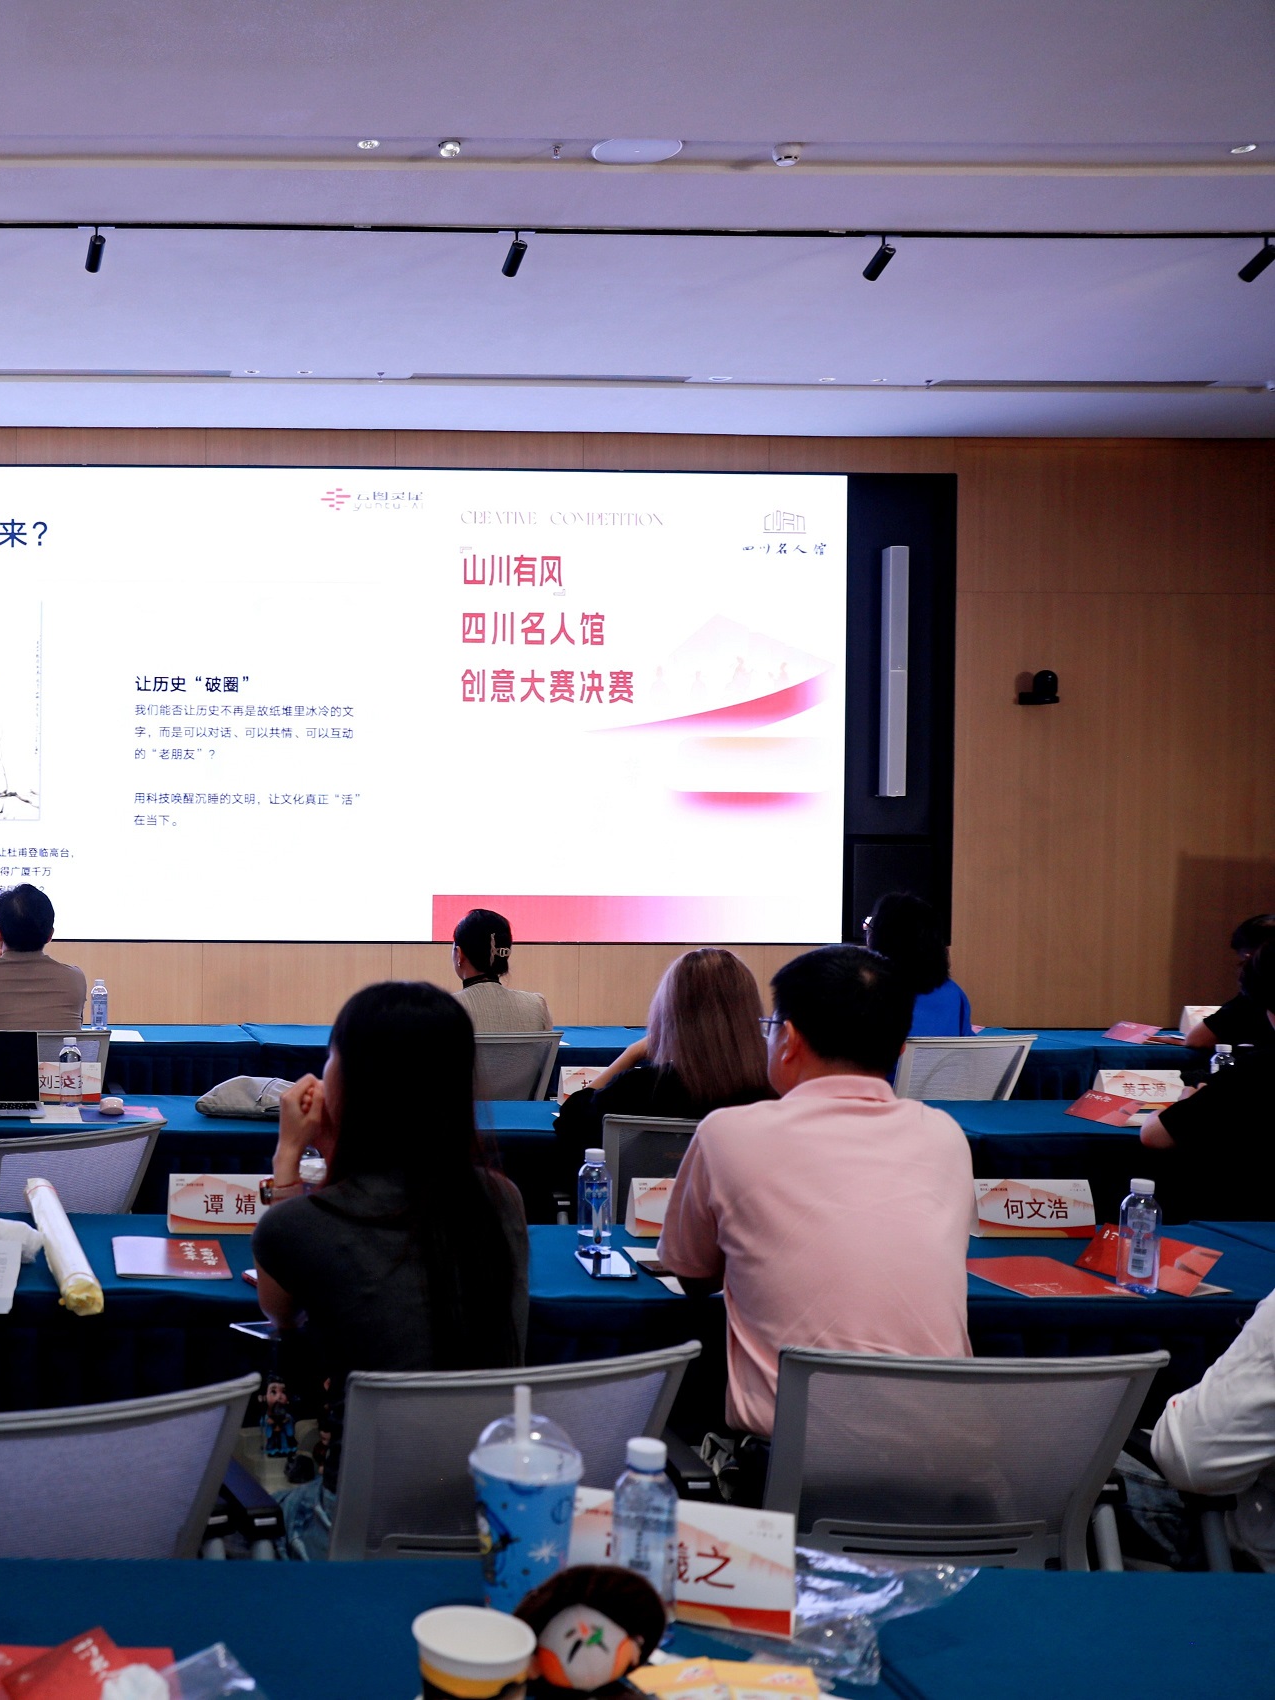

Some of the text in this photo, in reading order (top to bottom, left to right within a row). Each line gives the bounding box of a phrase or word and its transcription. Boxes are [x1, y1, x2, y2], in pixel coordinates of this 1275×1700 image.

[460, 510, 664, 527] CREATIVE COMPETITION
[742, 542, 827, 556] 四川名人馆
[461, 611, 605, 646] 四川名人馆
[134, 675, 250, 694] 让历史“破圈”
[460, 668, 634, 704] 创意大赛决赛
[134, 703, 354, 718] 我们能否让历史不再是故纸堆里冰冷的文
[133, 814, 177, 827] 在当下。
[1122, 1082, 1167, 1098] 黄天源
[1003, 1197, 1069, 1220] 何文浩
